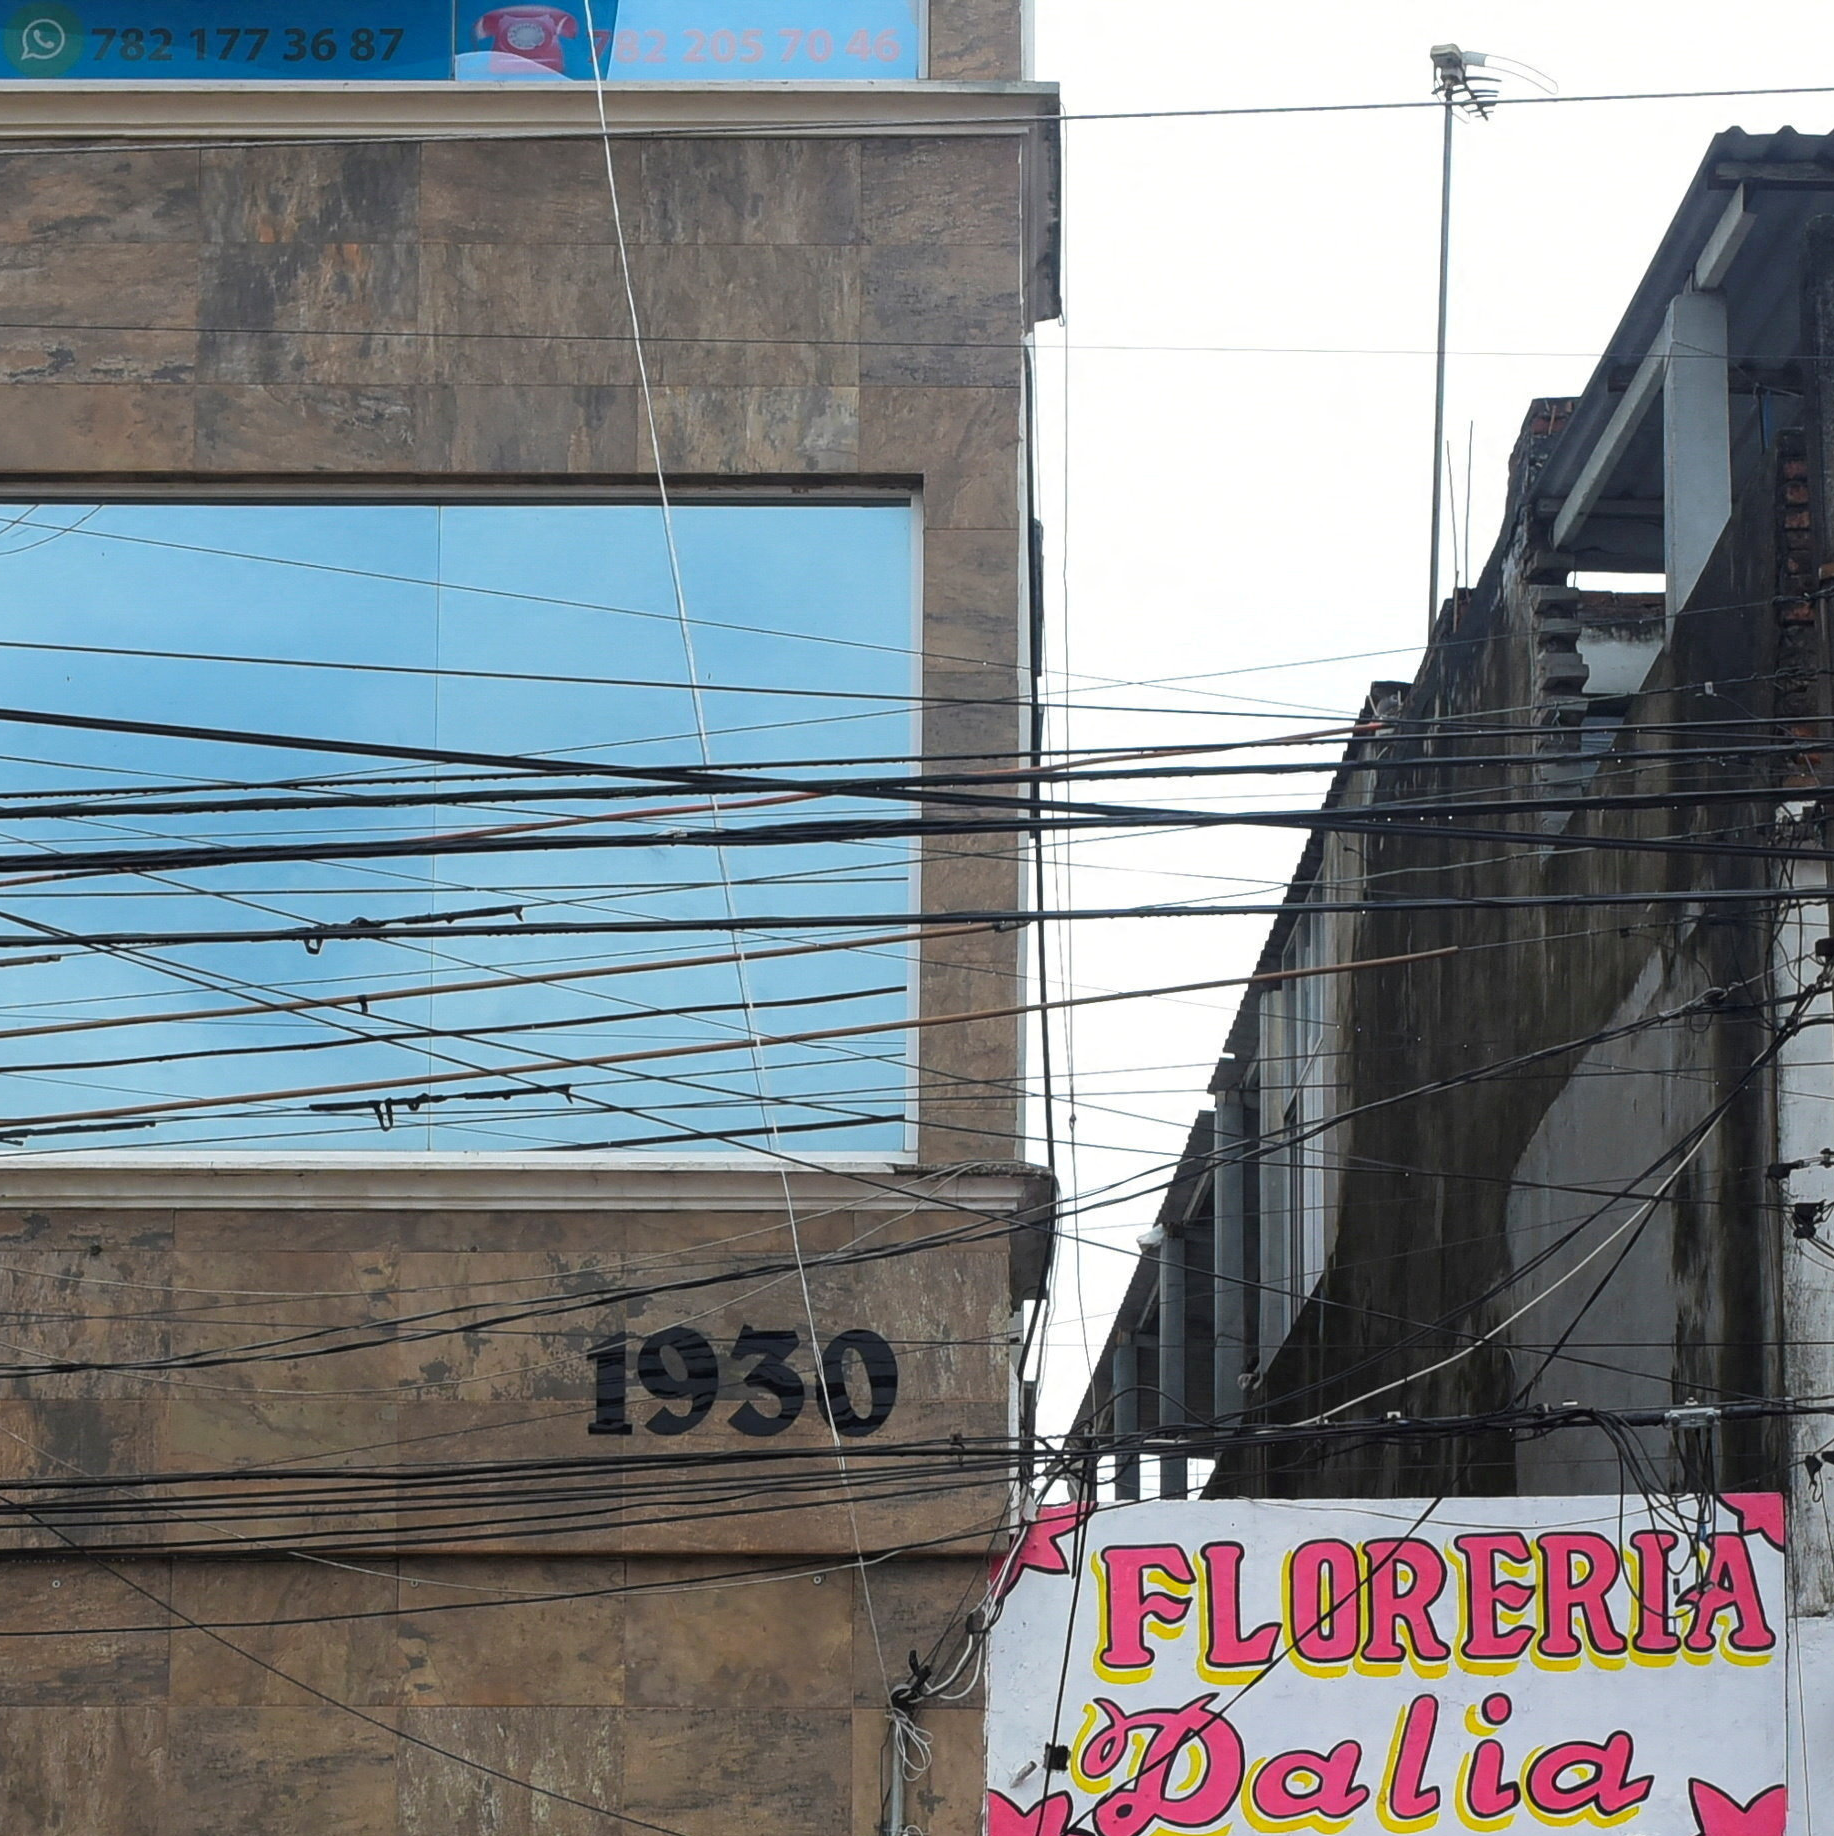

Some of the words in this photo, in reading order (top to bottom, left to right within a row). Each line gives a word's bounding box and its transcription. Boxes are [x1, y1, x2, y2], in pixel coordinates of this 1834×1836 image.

[91, 27, 174, 62] 782
[189, 28, 270, 62] 177
[283, 27, 337, 62] 36
[349, 27, 405, 62] 87
[587, 29, 667, 63] 782
[683, 29, 765, 63] 205
[779, 29, 833, 63] 70
[845, 29, 900, 62] 46
[587, 1325, 898, 1437] 1930
[1095, 1530, 1776, 1682] FLORERIA
